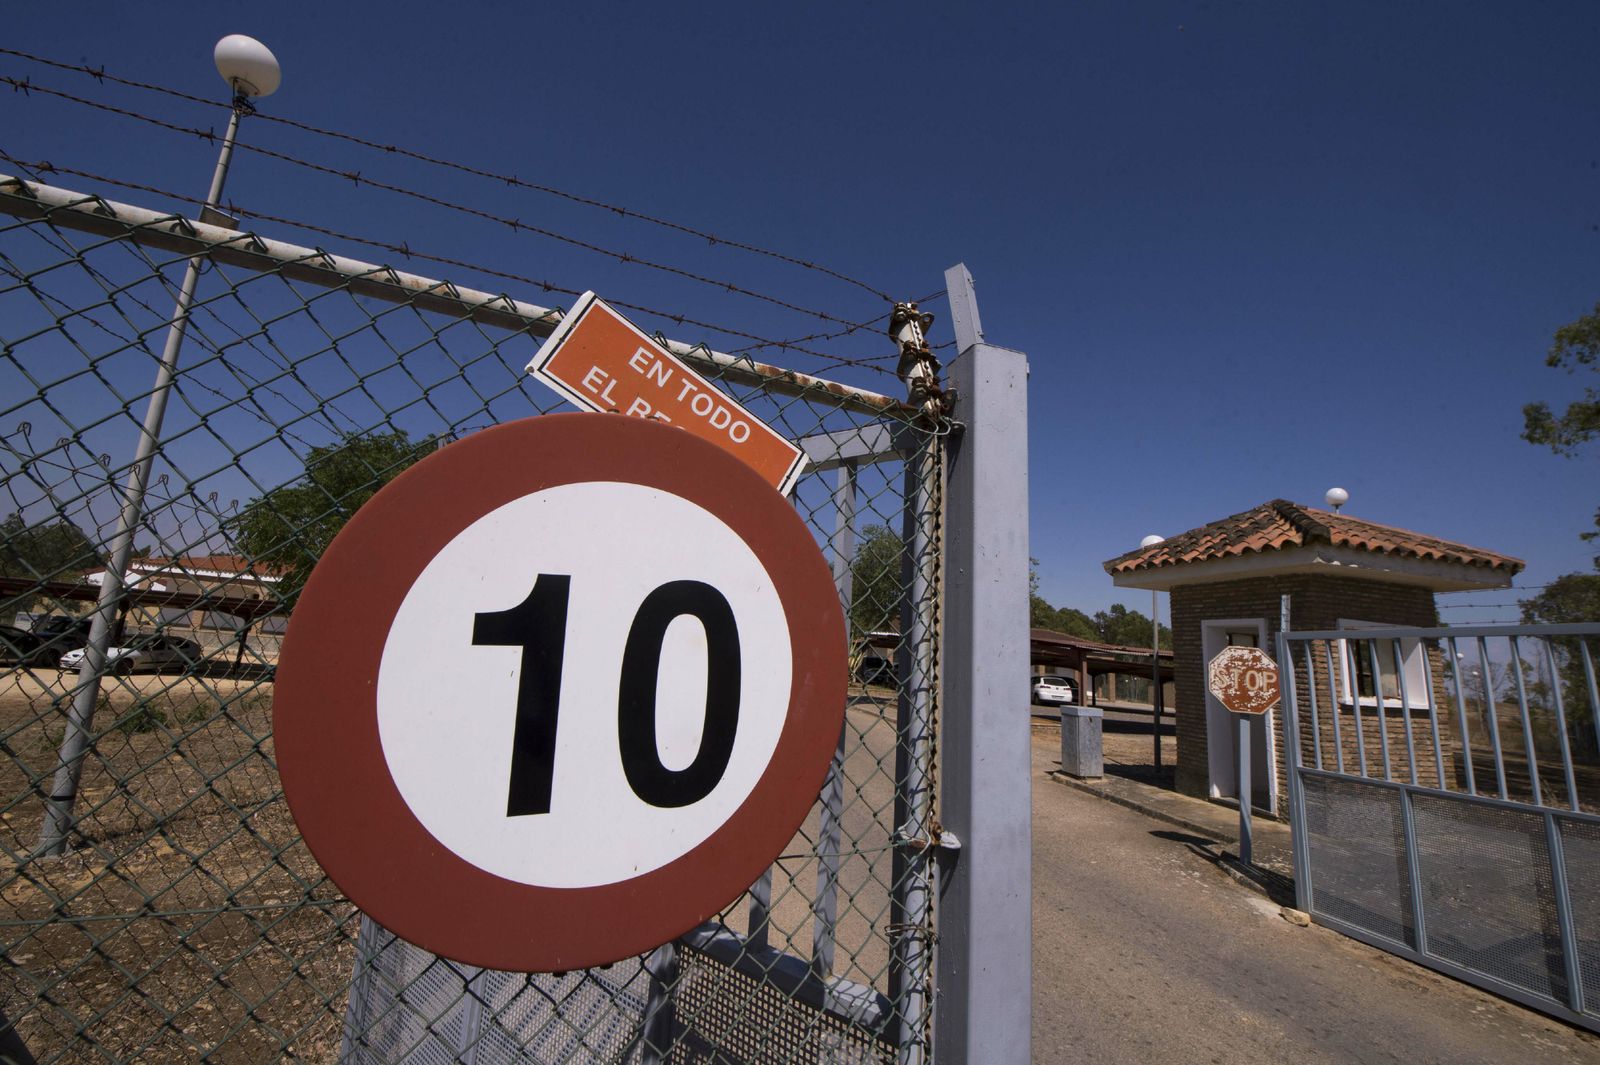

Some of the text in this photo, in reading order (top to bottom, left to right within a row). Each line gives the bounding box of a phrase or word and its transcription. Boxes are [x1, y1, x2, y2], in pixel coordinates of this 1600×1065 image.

[581, 366, 617, 406] EL
[628, 346, 674, 387] EN
[677, 378, 751, 443] TODO
[471, 573, 742, 817] 10
[1217, 668, 1277, 692] STOP
